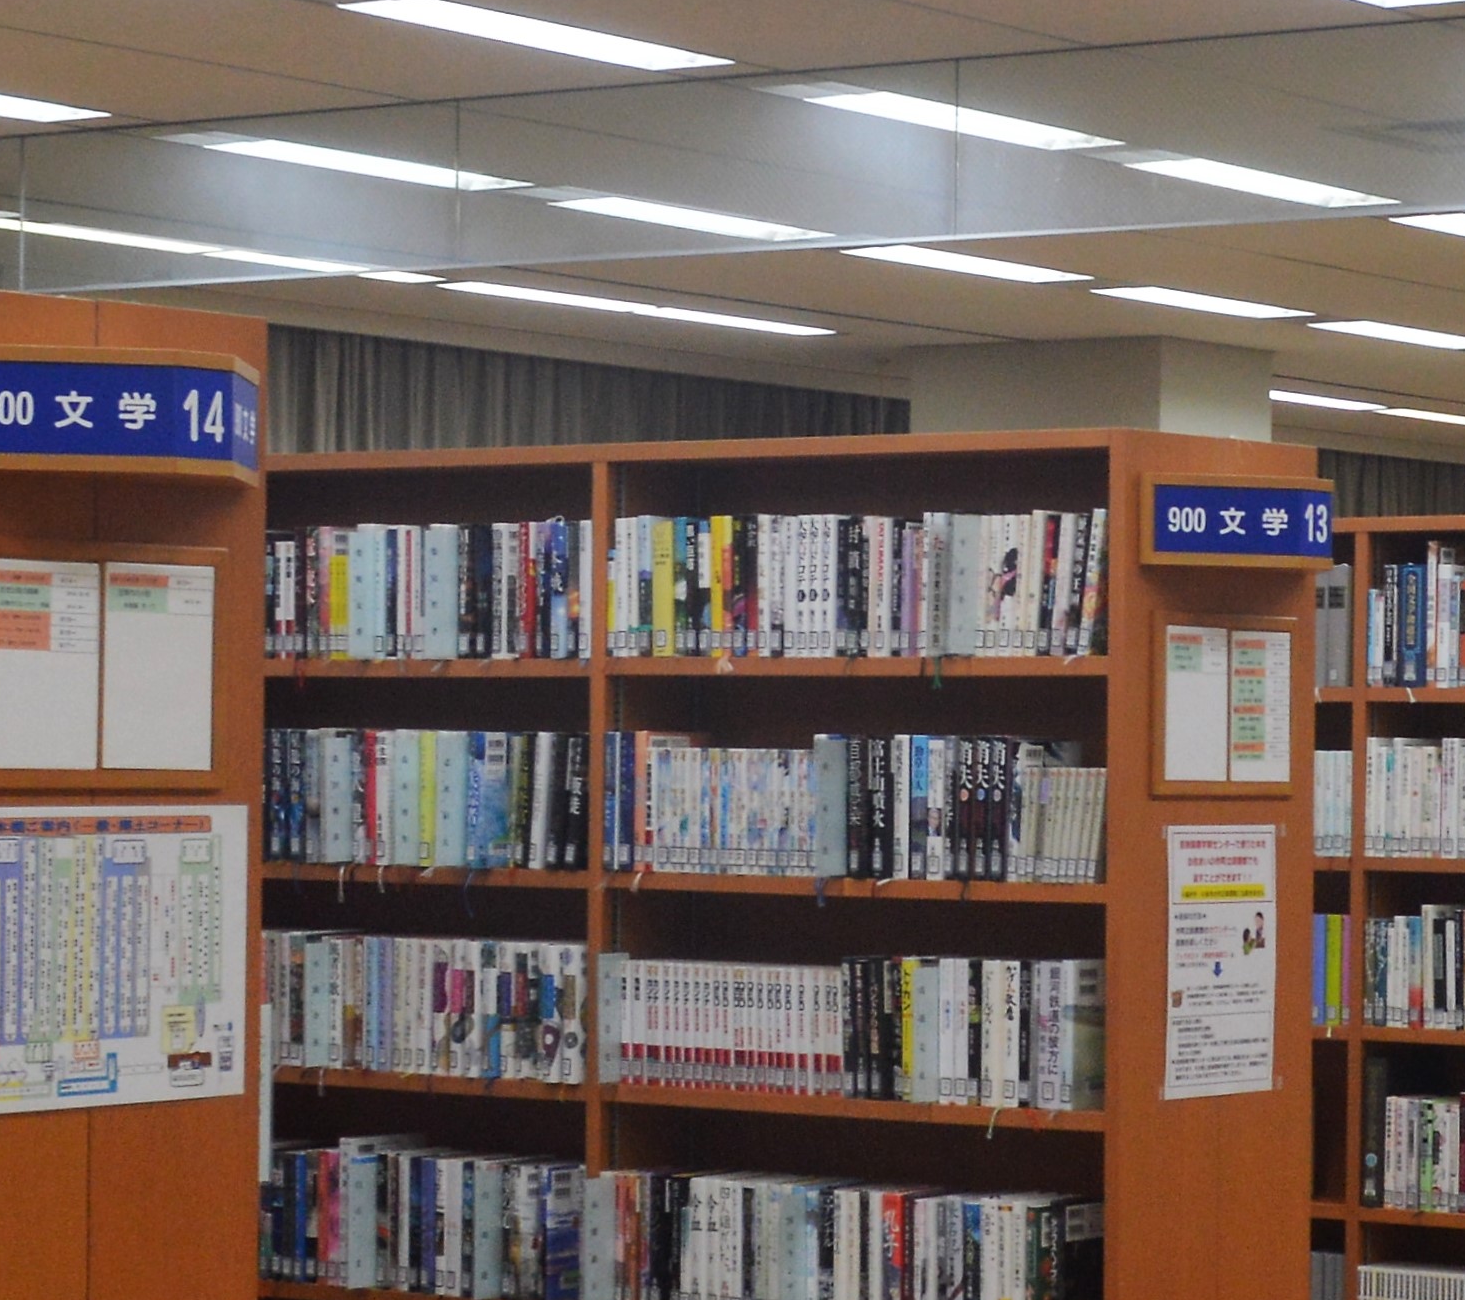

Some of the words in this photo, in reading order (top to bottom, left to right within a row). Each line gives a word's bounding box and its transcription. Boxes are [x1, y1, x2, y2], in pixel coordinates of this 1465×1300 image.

[54, 390, 157, 430] 文学
[183, 389, 225, 443] 14
[1168, 506, 1206, 533] 900
[1219, 506, 1288, 536] 文学
[1304, 503, 1328, 543] 13
